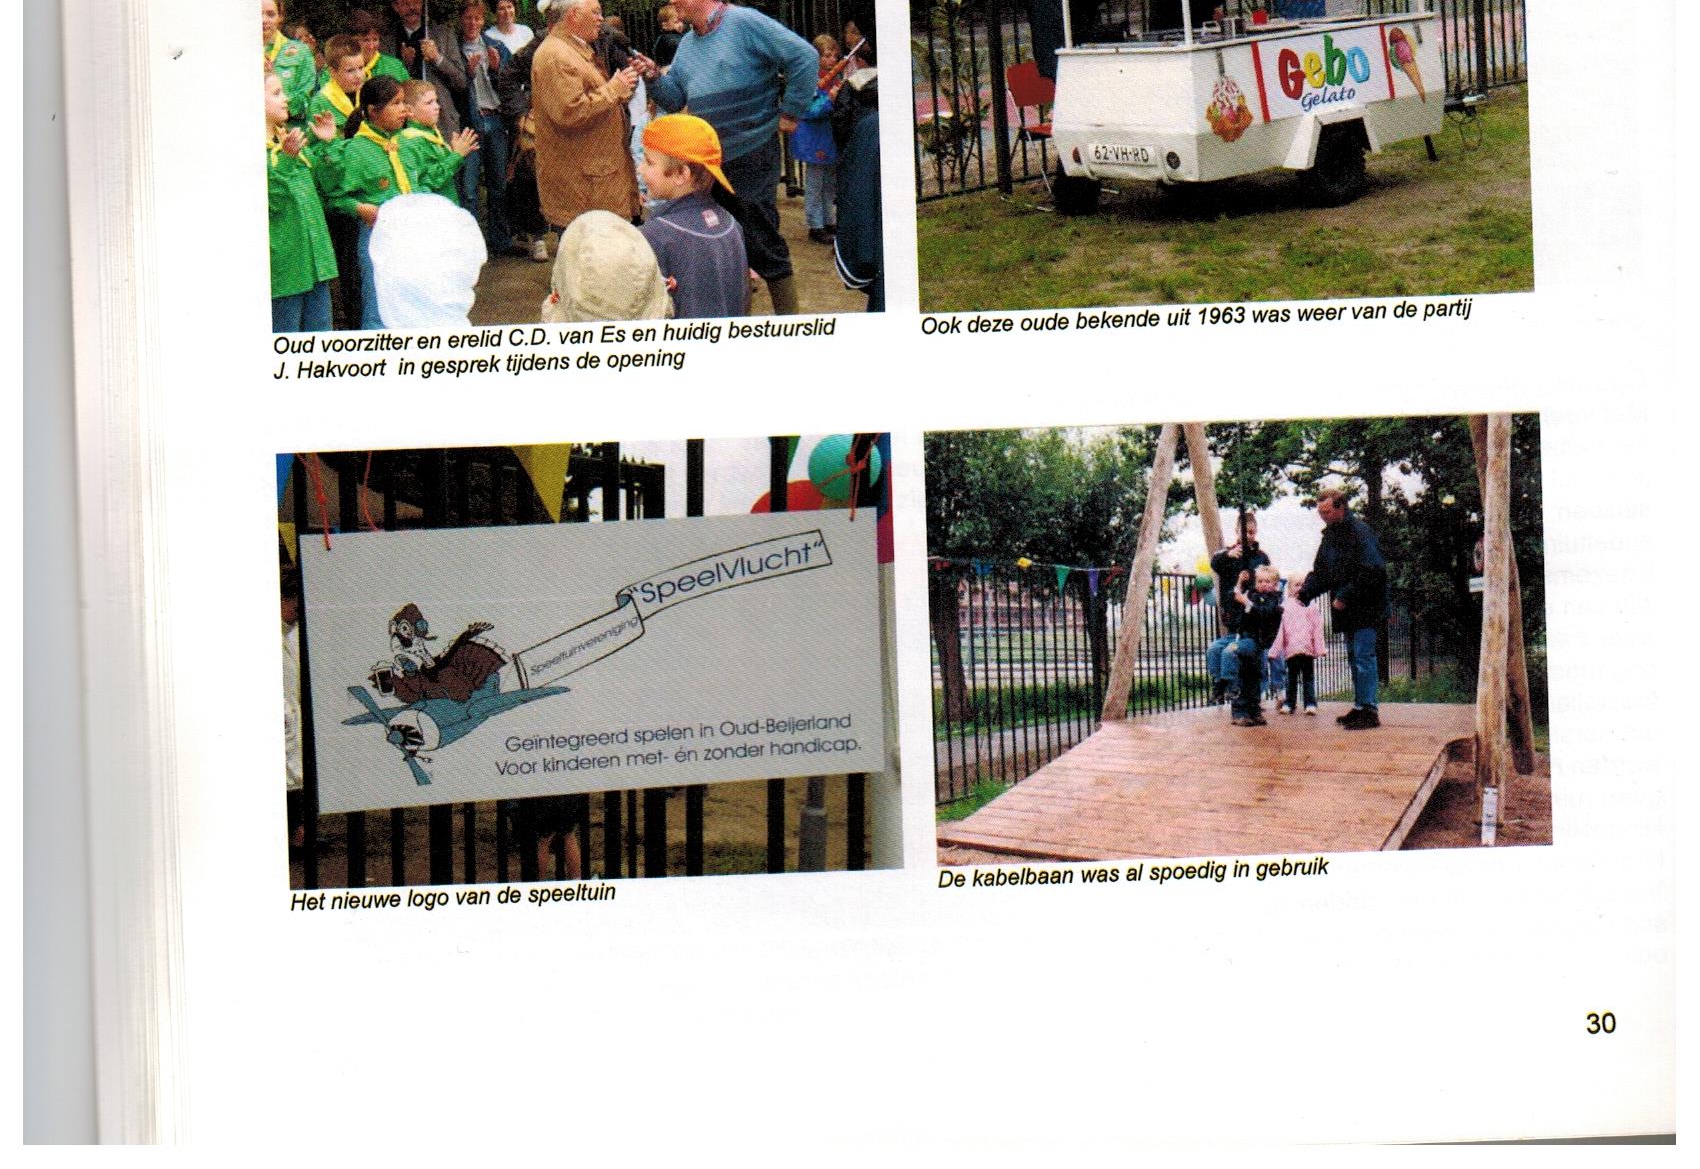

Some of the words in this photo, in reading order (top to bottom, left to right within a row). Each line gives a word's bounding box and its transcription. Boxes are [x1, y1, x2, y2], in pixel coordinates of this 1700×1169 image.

[1278, 31, 1370, 101] Gebo
[1301, 87, 1356, 111] Gelato
[921, 316, 963, 335] Ook
[967, 315, 1014, 333] deze
[1020, 312, 1070, 332] oude
[1075, 309, 1161, 330] bekende
[1167, 307, 1192, 327] uit
[1198, 306, 1246, 325] 1963
[1252, 308, 1291, 324] was
[1297, 306, 1347, 322] weer
[1351, 305, 1387, 320] van
[1393, 300, 1418, 319] de
[1423, 298, 1473, 322] partij
[273, 335, 316, 355] Oud
[321, 333, 414, 353] voorzitter
[417, 335, 441, 350] en
[447, 329, 503, 349] erelid
[508, 328, 551, 347] C.D.
[559, 330, 594, 345] van
[600, 325, 626, 344] Es
[632, 328, 657, 343] en
[663, 322, 722, 344] huidig
[728, 316, 836, 339] bestuurslid
[273, 361, 289, 380] J.
[297, 358, 387, 379] Hakvoort
[398, 357, 415, 376] in
[421, 354, 501, 379] gesprek
[506, 353, 570, 376] tijdens
[576, 351, 601, 370] de
[607, 348, 686, 373] opening
[634, 725, 695, 745] spelen
[699, 722, 714, 738] in
[719, 714, 852, 737] Oud-Beijerland
[495, 760, 537, 776] Voor
[543, 755, 620, 773] kinderen
[626, 749, 669, 767] met-
[703, 742, 765, 761] zonder
[769, 737, 862, 755] handicap.
[938, 870, 966, 889] De
[972, 867, 1074, 887] kabelbaan
[1081, 868, 1120, 884] was
[1126, 863, 1144, 882] al
[1149, 860, 1227, 885] spoedig
[1233, 860, 1250, 878] in
[1256, 857, 1330, 882] gebruik
[290, 892, 326, 912] Het
[331, 891, 402, 910] nieuwe
[407, 889, 450, 912] logo
[455, 890, 491, 906] van
[497, 886, 522, 905] de
[528, 882, 616, 907] speeltuin
[1586, 1012, 1617, 1035] 30
